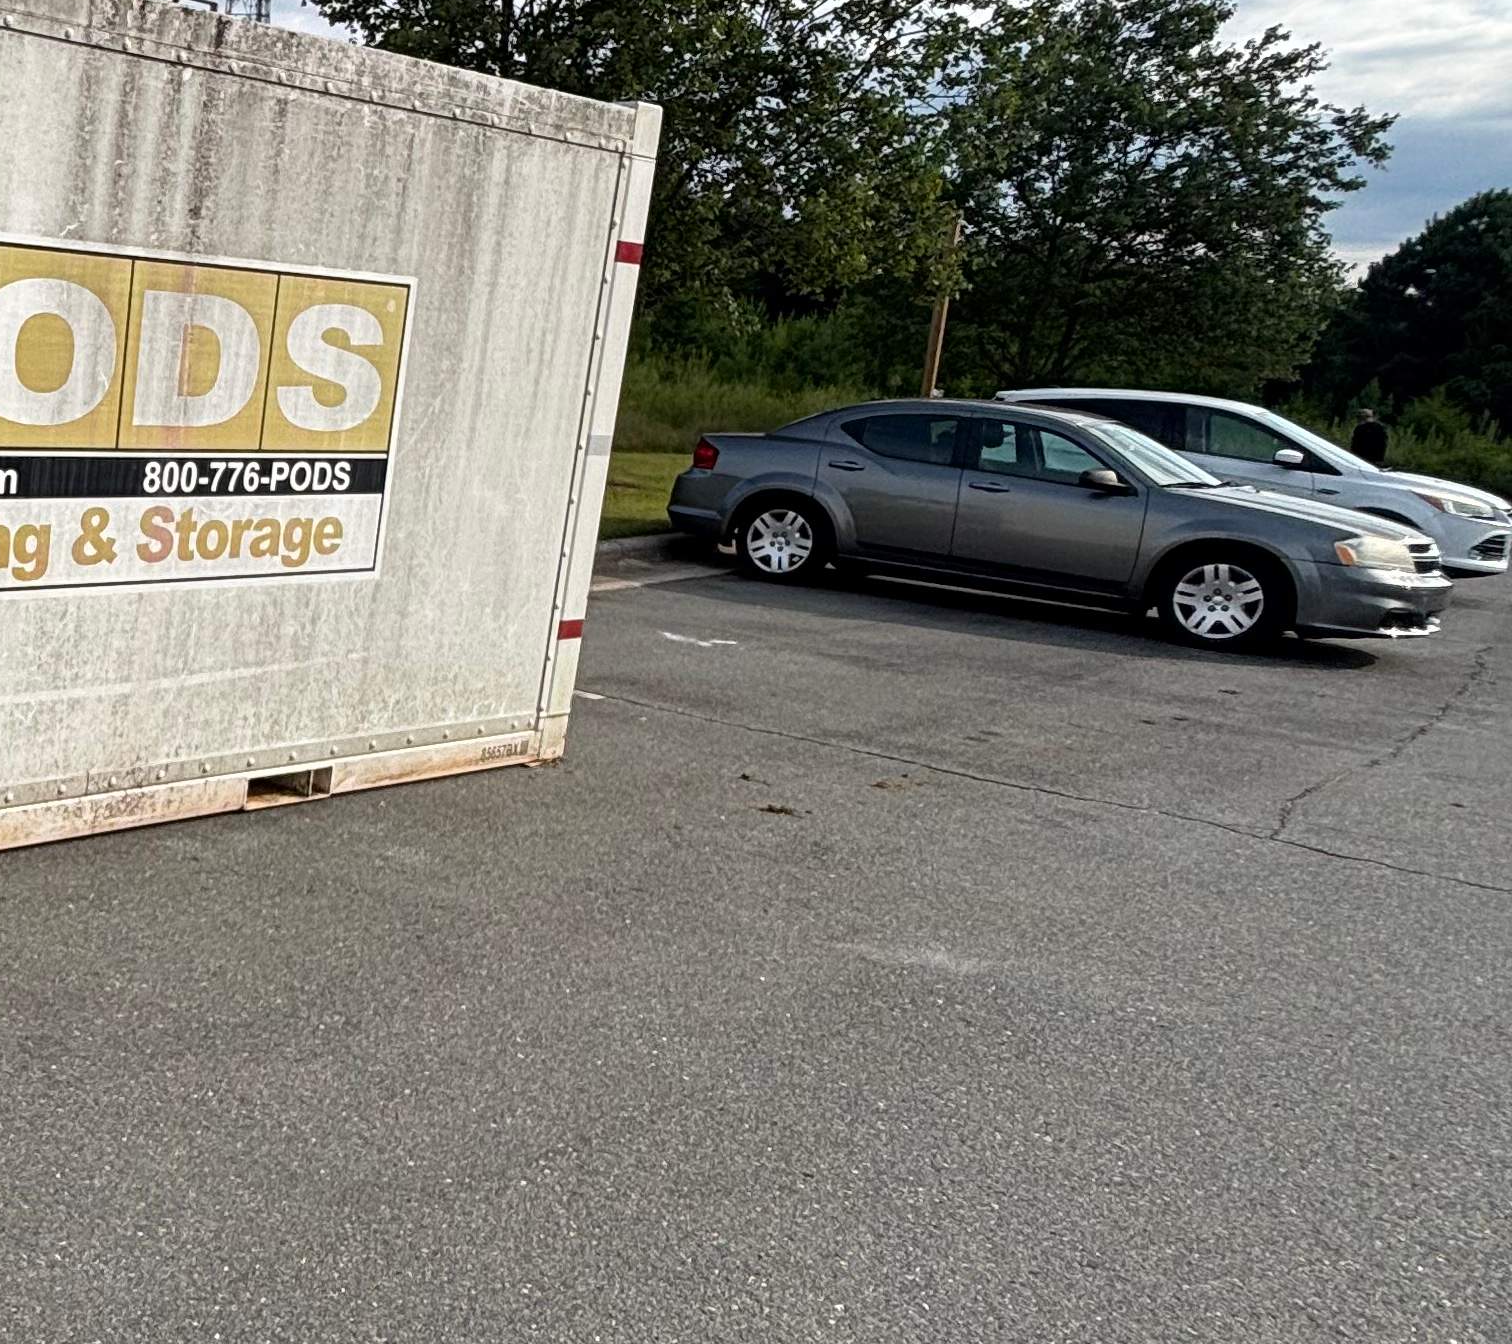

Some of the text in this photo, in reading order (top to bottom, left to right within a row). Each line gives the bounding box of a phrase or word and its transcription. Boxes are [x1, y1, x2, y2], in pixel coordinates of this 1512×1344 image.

[142, 460, 353, 494] 800-776-PODS
[71, 506, 118, 566] &
[136, 505, 345, 568] Storage
